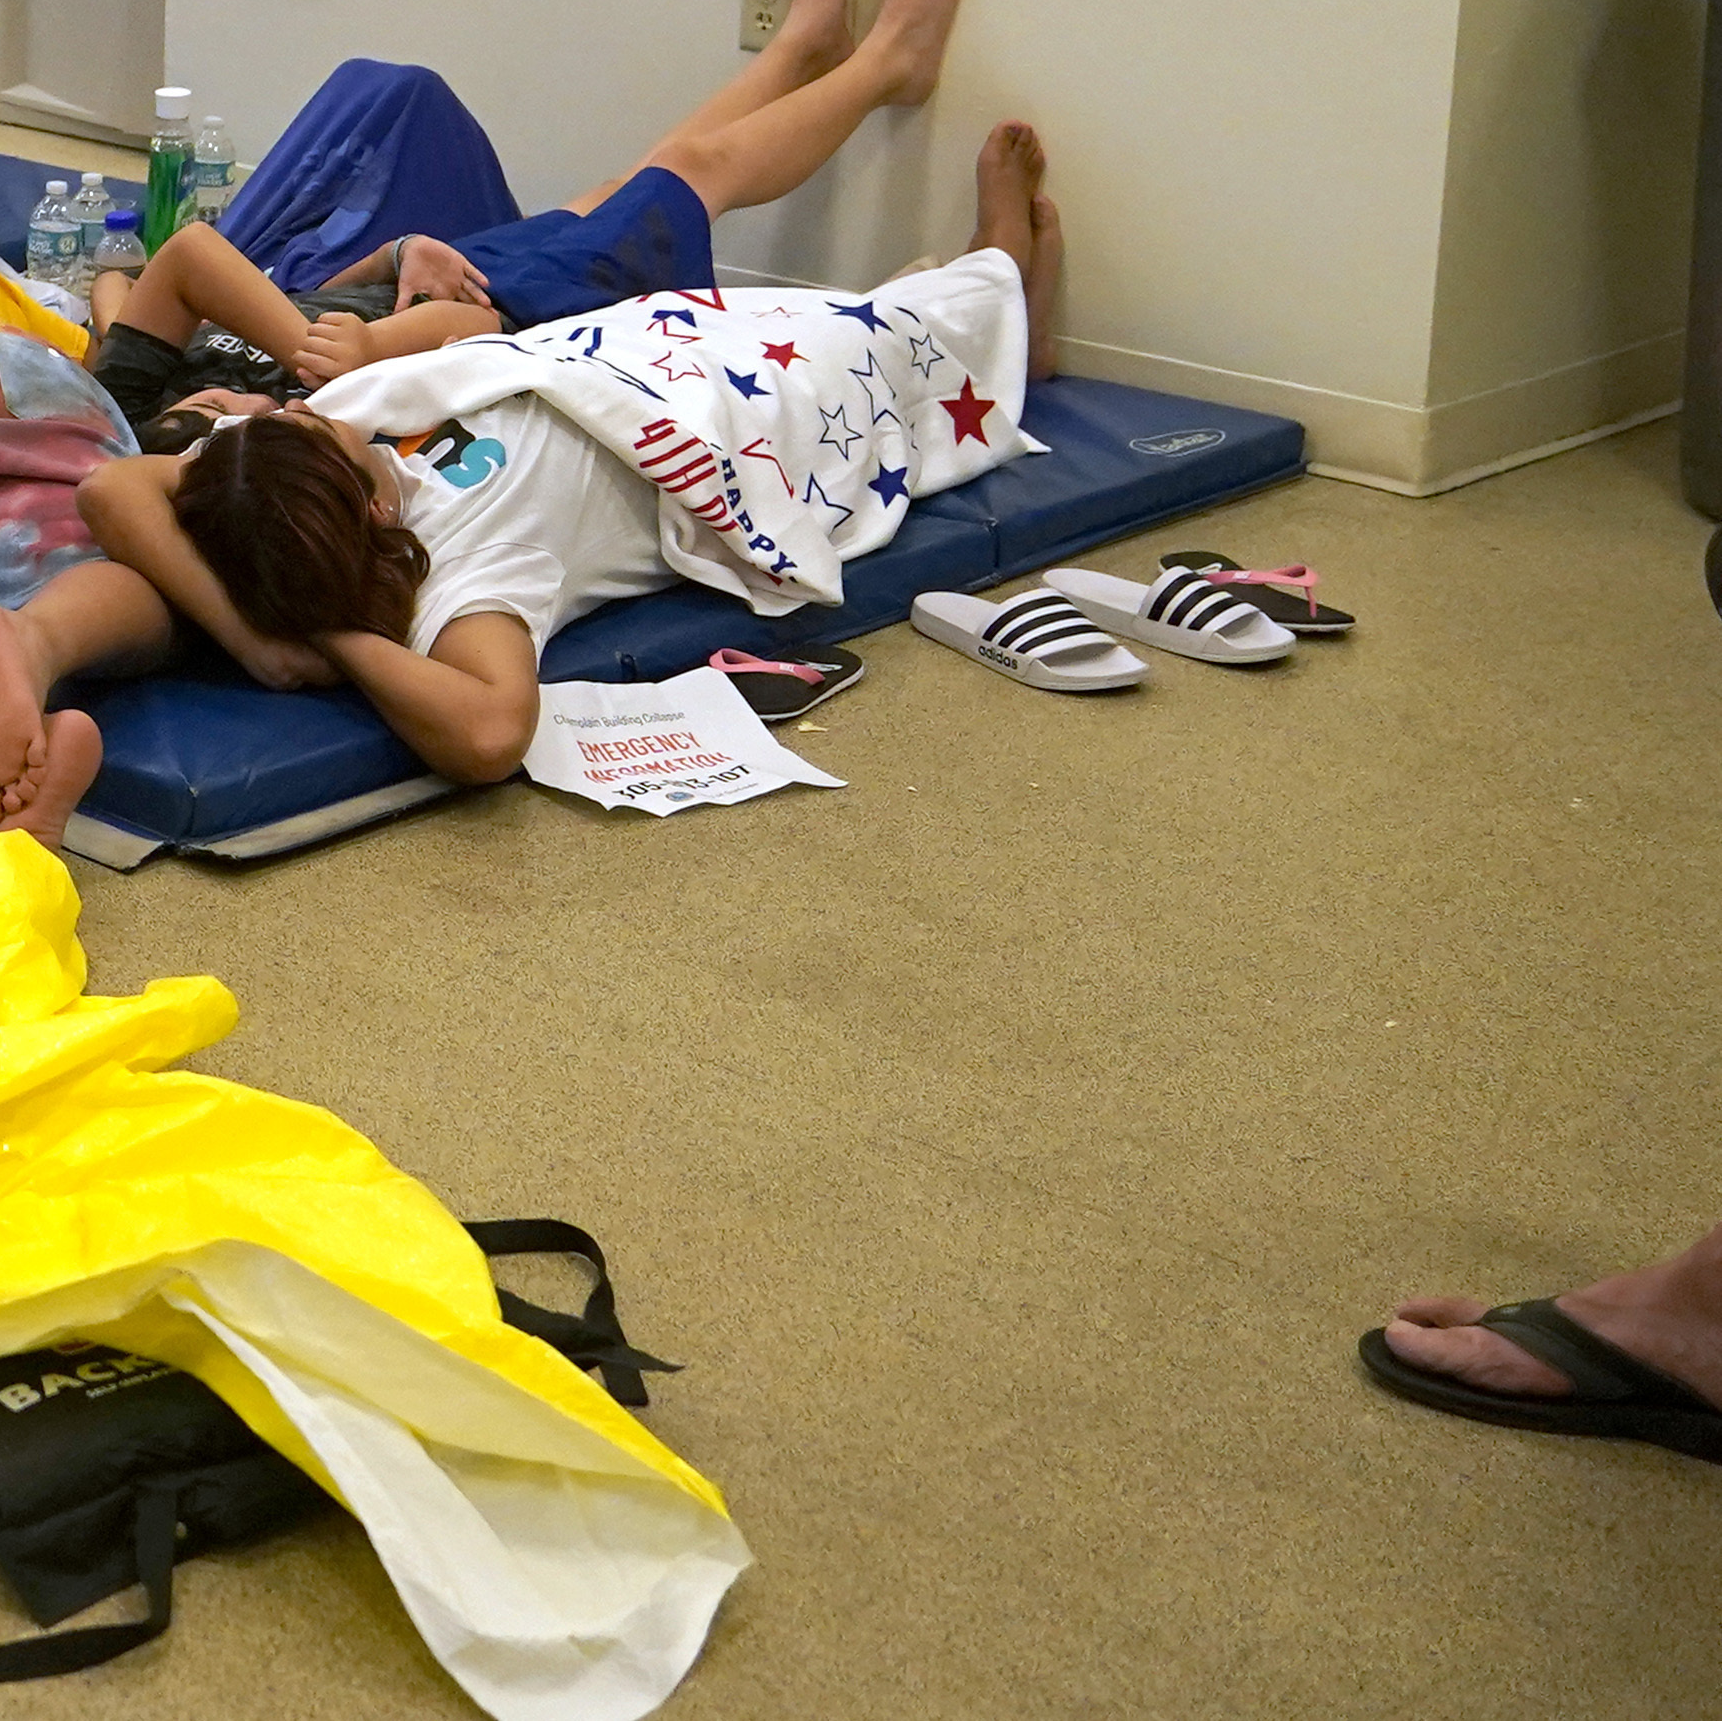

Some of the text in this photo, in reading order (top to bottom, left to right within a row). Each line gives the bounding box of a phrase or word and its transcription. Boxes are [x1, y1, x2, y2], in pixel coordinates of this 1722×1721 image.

[721, 456, 799, 575] HAPPY
[977, 644, 1019, 671] adidas
[601, 715, 645, 728] Building
[576, 731, 702, 763] EMERGENCY
